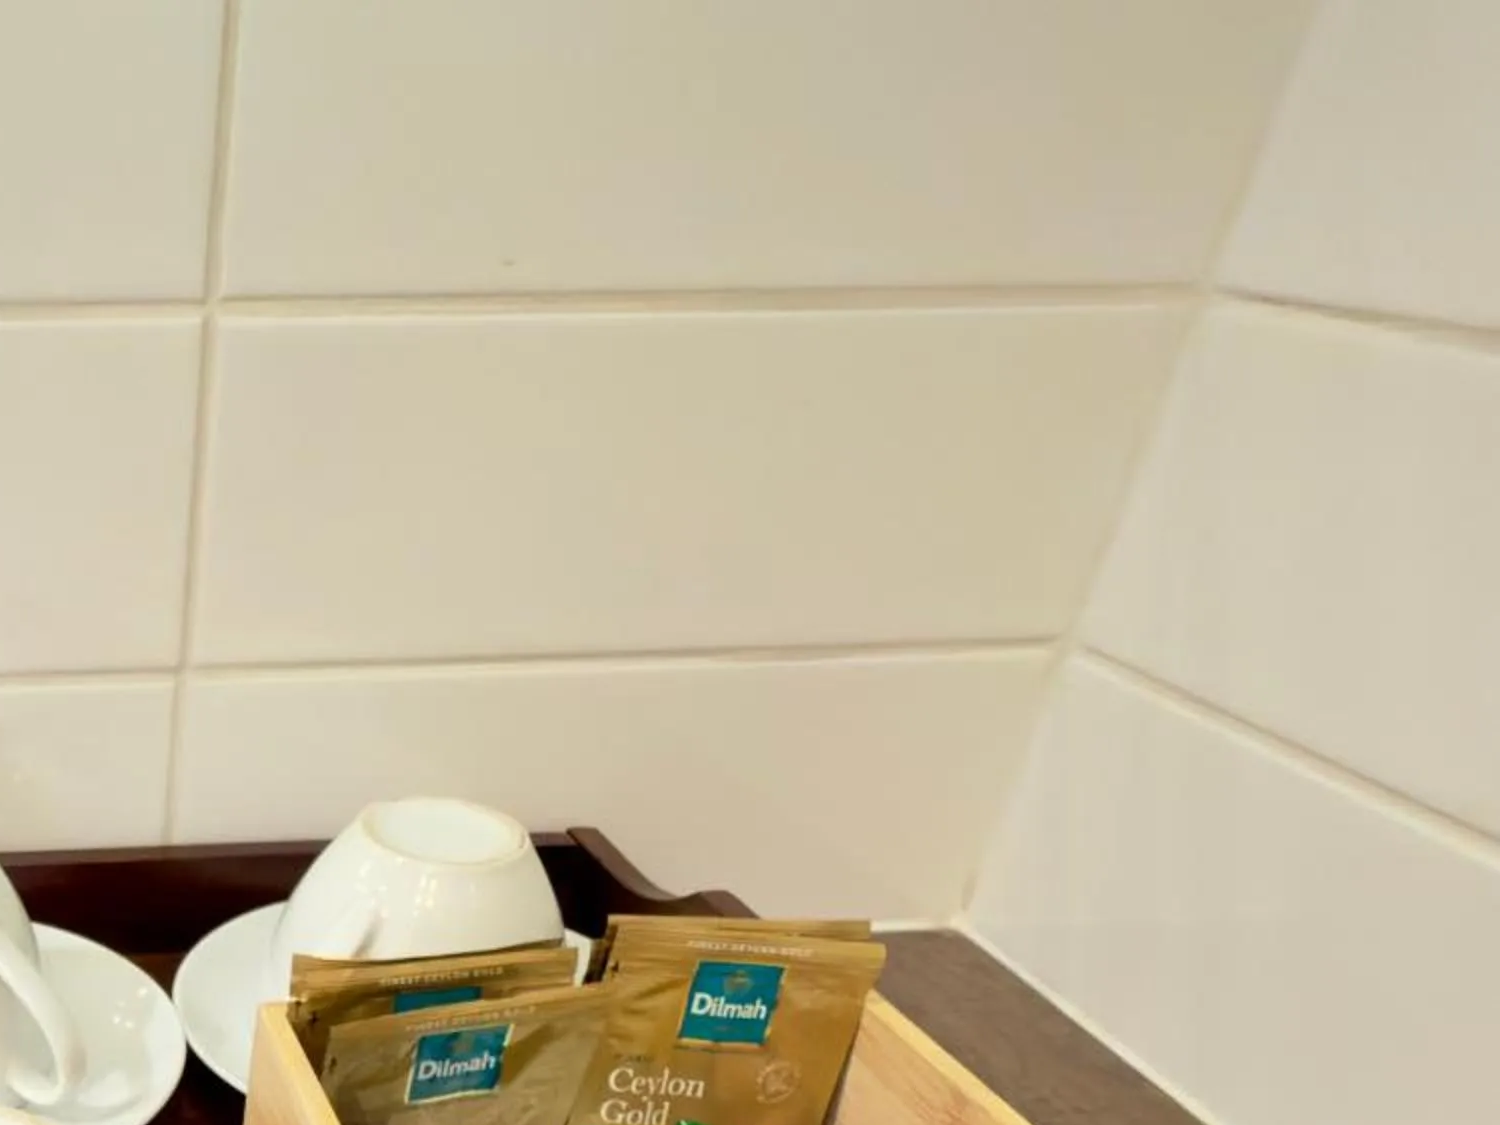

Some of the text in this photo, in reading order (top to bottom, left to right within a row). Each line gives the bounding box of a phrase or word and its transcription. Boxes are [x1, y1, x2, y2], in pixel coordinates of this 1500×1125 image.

[690, 991, 768, 1021] Dilmah
[417, 1050, 496, 1082] Dilmah
[607, 1063, 706, 1101] Ceylon
